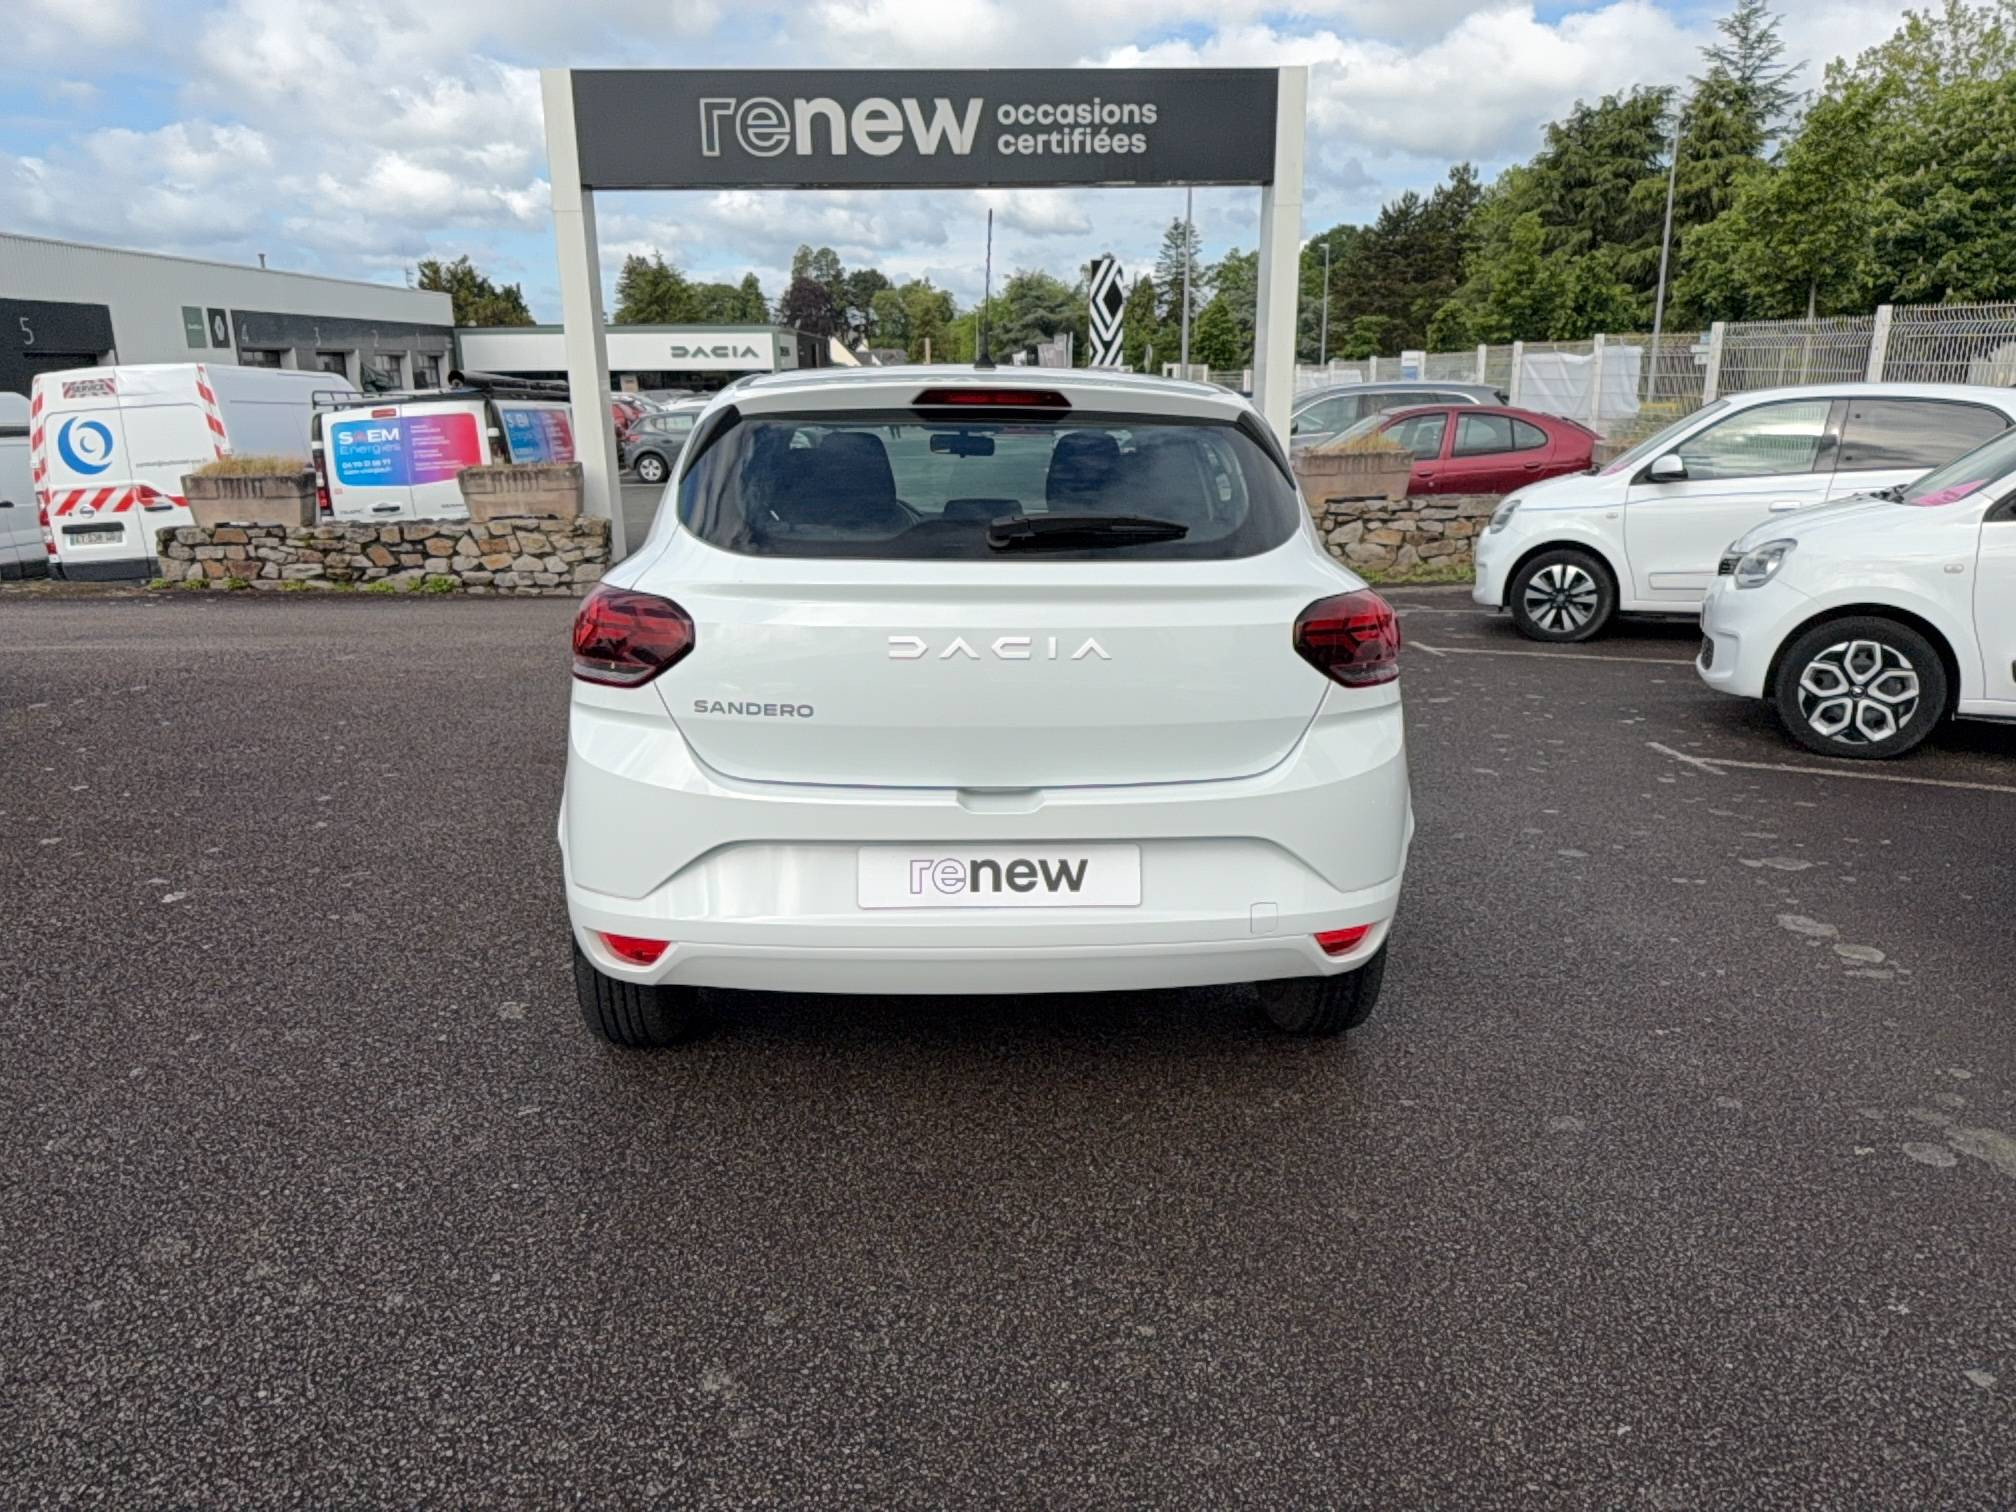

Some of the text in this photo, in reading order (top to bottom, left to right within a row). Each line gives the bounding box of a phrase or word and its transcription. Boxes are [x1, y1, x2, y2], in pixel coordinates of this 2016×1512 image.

[997, 97, 1157, 125] occasions
[699, 97, 984, 157] renew
[997, 127, 1147, 155] certifiées
[20, 317, 35, 345] 5
[241, 323, 249, 343] 4
[313, 326, 321, 347] 3
[371, 329, 380, 348] 2
[670, 345, 759, 358] DACIA
[888, 635, 1112, 660] DACIA
[693, 699, 814, 718] SANDERO
[909, 858, 1089, 895] renew
